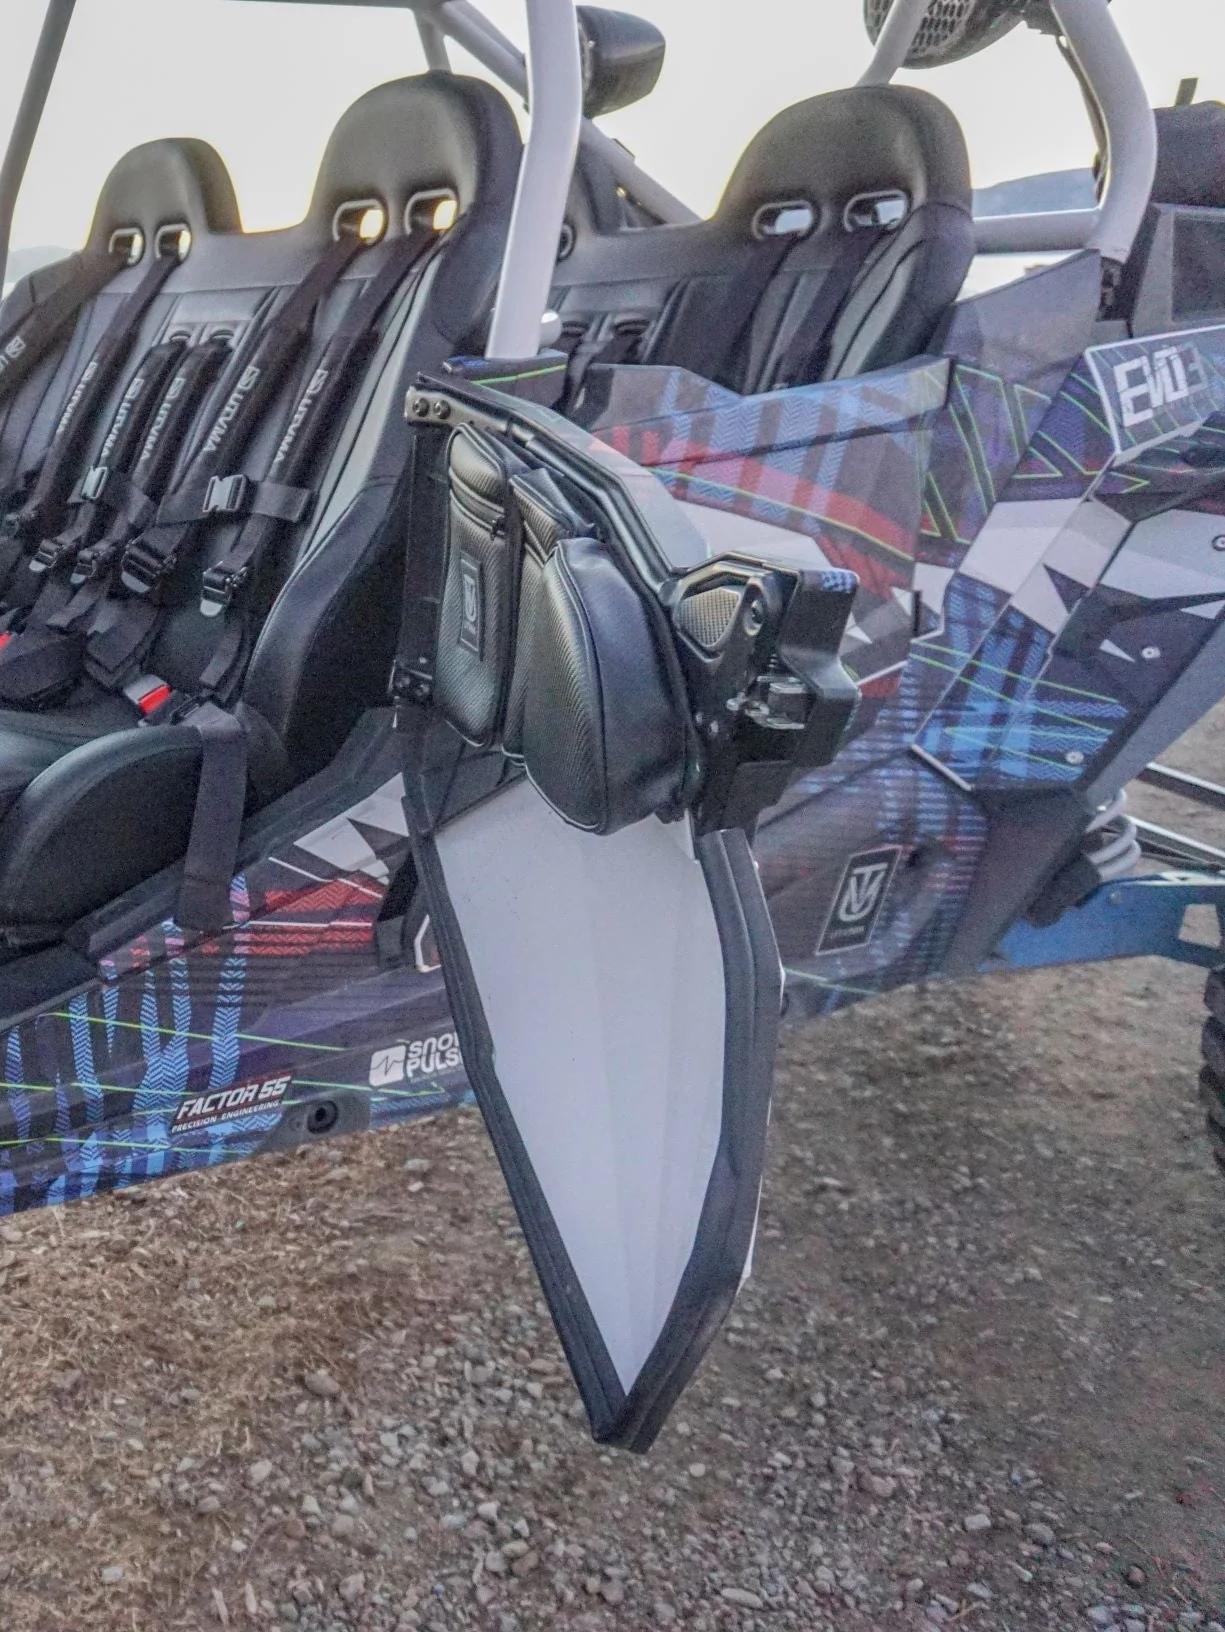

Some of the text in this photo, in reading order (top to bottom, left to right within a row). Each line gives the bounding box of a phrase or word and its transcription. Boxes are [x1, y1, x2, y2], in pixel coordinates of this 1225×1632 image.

[203, 392, 244, 452] UTVMA
[171, 1099, 279, 1134] PRECISION ENGINEERING
[177, 1075, 292, 1120] FACTOR 55
